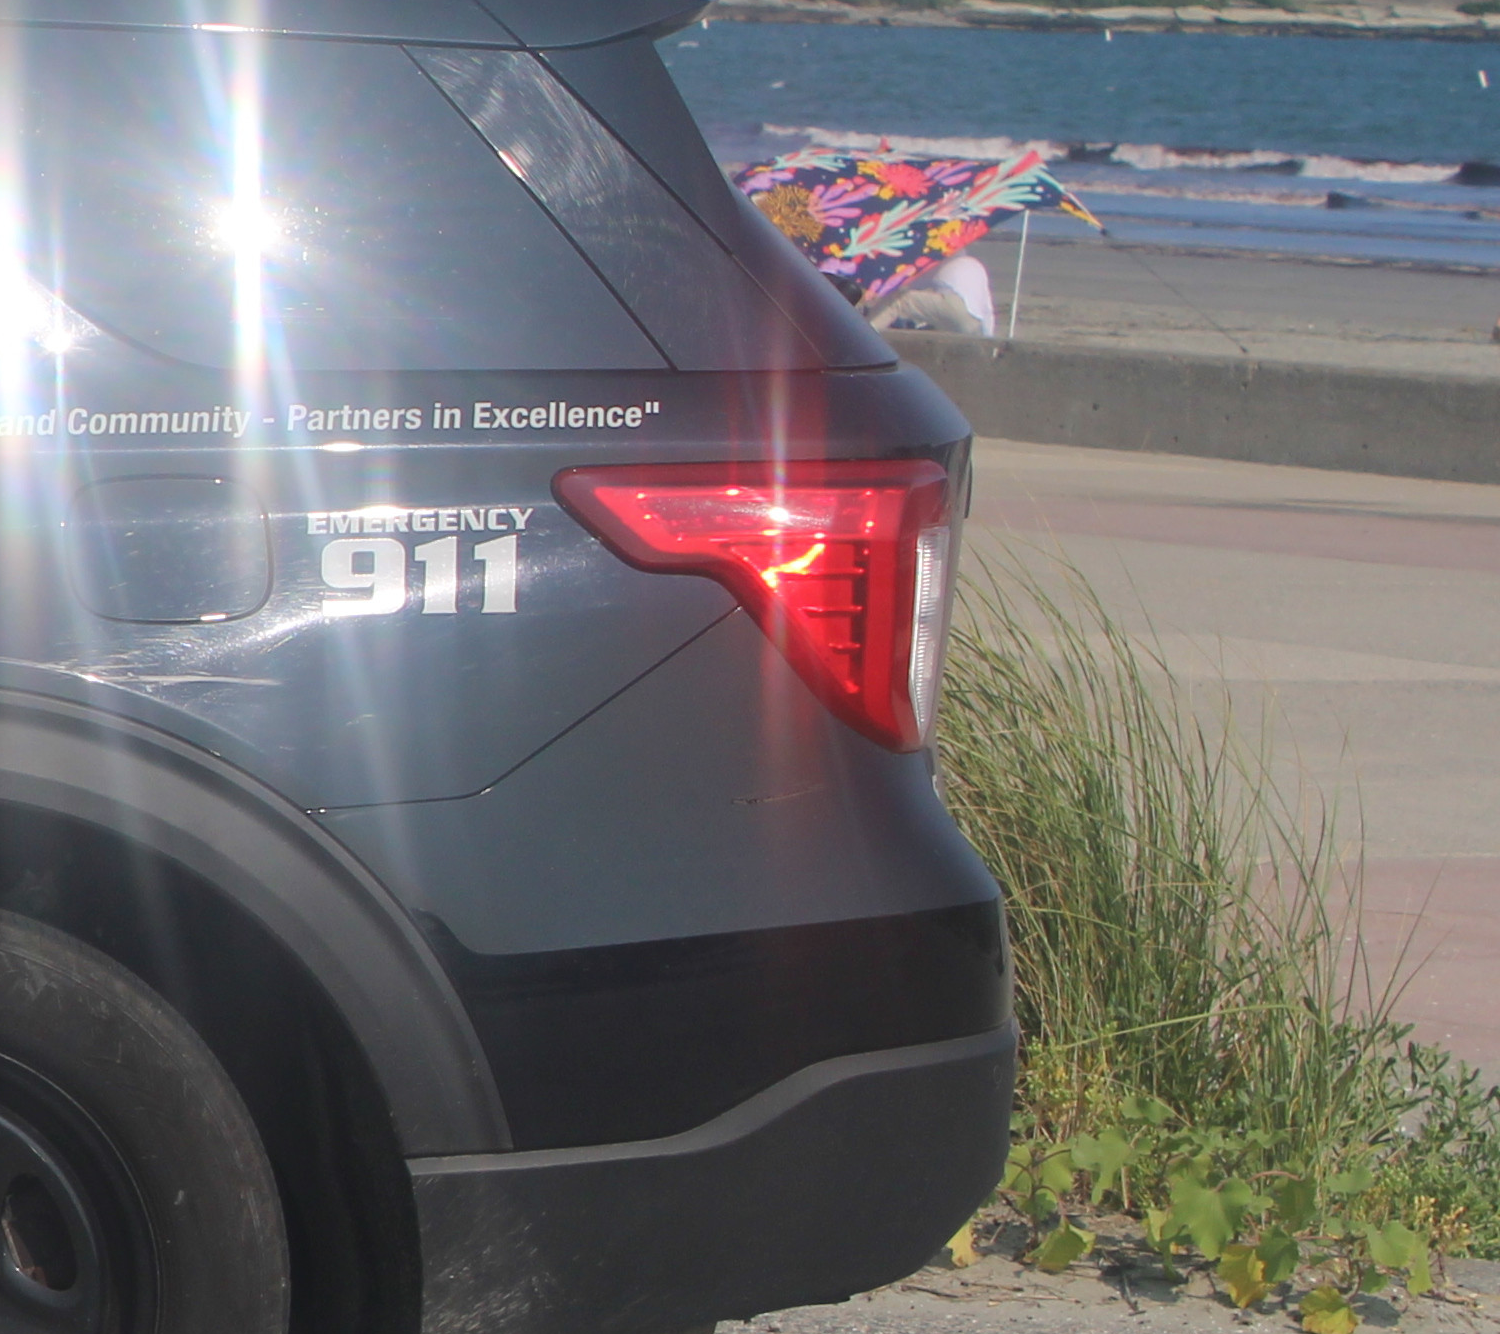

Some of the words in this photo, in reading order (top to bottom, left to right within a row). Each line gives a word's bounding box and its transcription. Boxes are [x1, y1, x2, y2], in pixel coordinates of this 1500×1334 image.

[67, 405, 252, 438] Community
[287, 403, 422, 432] Partners
[432, 402, 461, 430] in
[473, 400, 660, 430] Excellence"
[306, 507, 535, 535] EMERGENCY
[320, 534, 518, 617] 911
